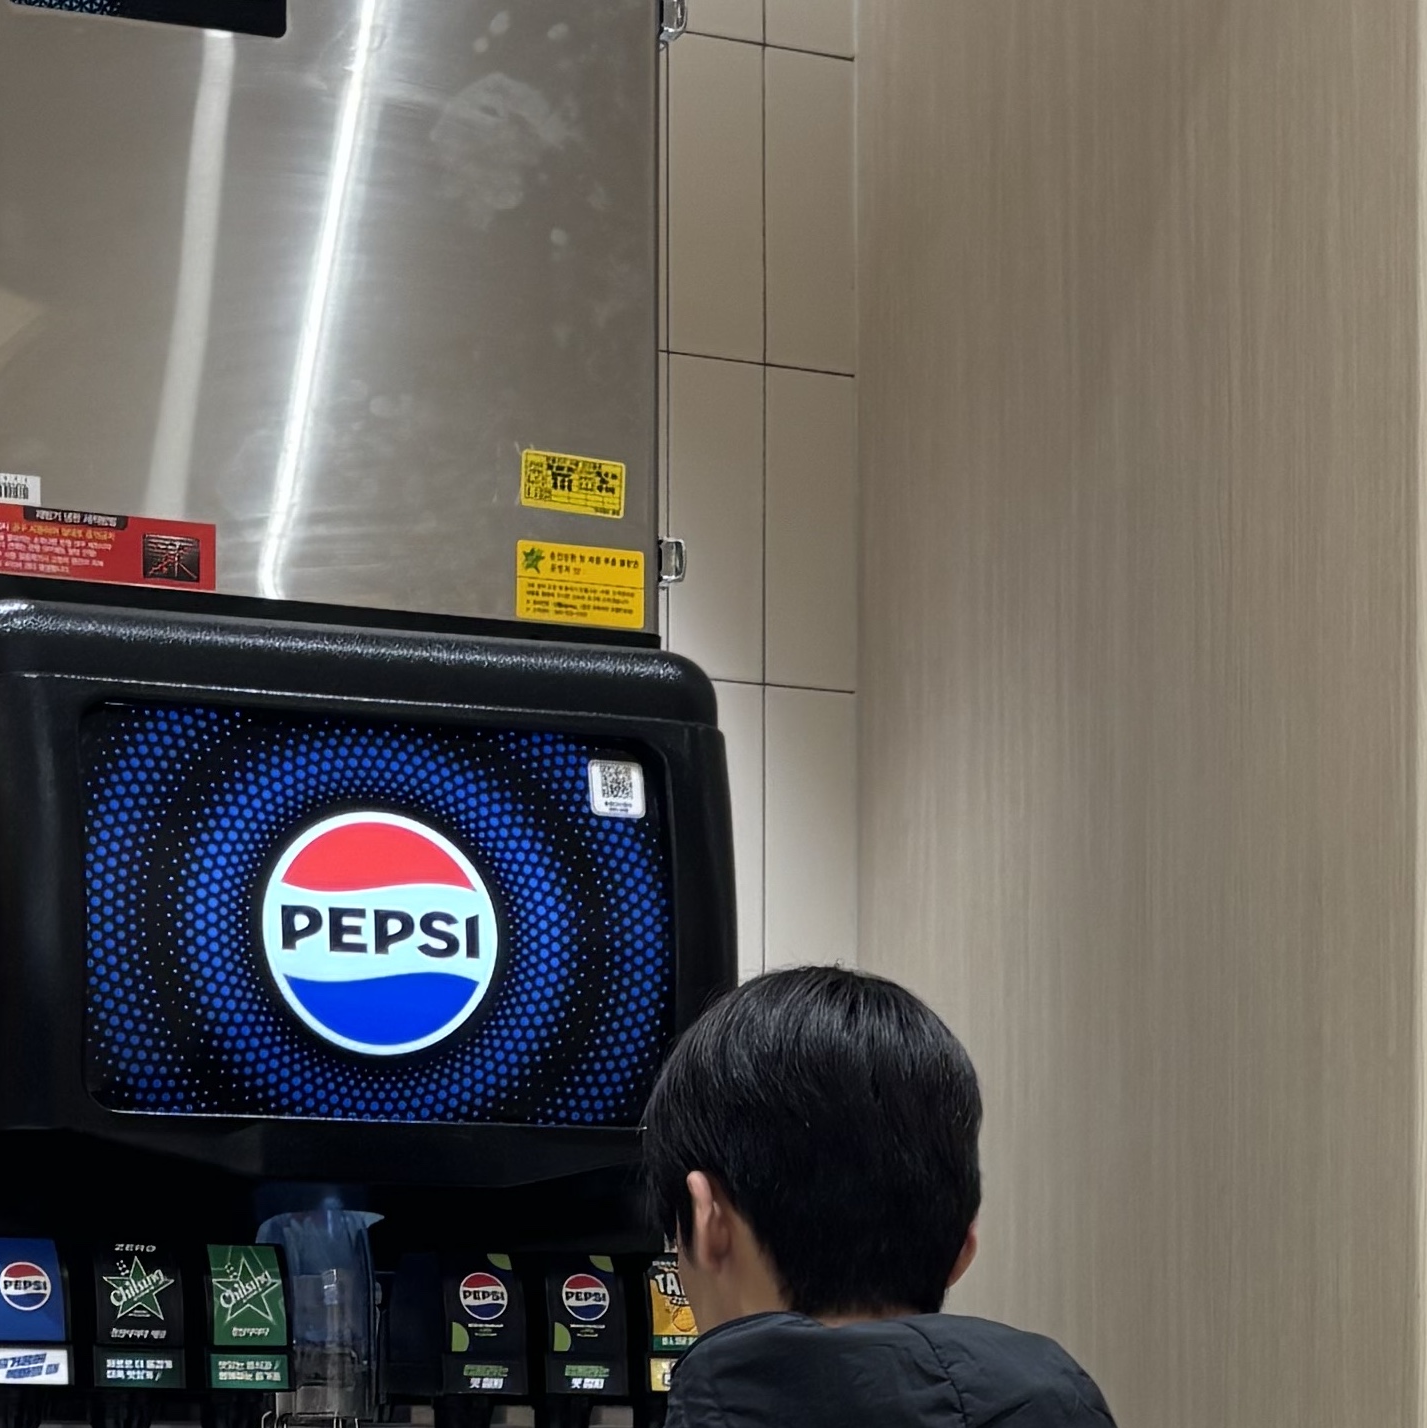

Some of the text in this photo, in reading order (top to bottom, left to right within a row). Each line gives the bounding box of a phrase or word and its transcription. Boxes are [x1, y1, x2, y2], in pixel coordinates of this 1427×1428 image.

[281, 904, 480, 960] PEPSI
[114, 1243, 156, 1253] ZERO
[3, 1279, 48, 1291] PEPSI
[654, 1271, 685, 1297] TA
[462, 1289, 505, 1302] PEPSI
[565, 1290, 607, 1303] PEPSI
